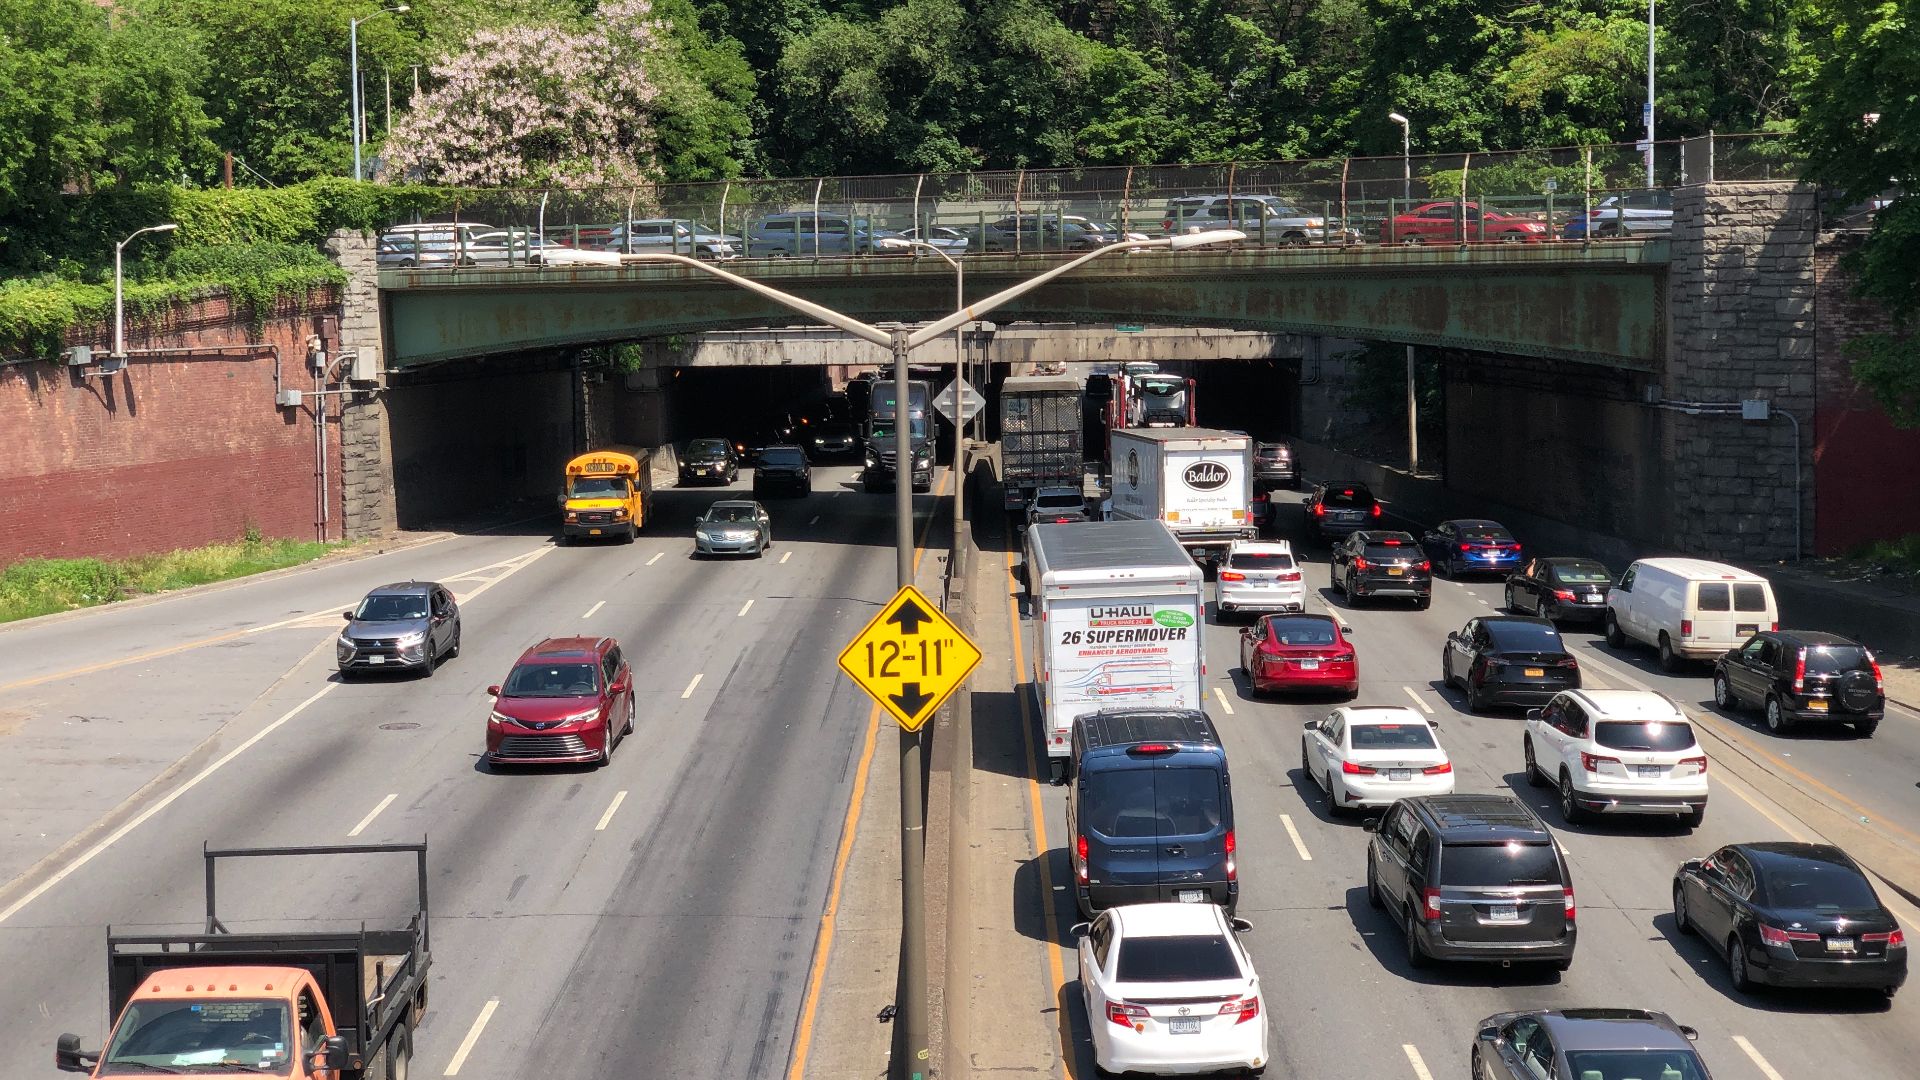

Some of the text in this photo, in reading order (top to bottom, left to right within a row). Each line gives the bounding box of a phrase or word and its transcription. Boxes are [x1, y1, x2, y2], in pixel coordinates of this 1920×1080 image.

[1187, 465, 1226, 483] Baldor
[1091, 606, 1151, 618] U-HAUL
[1086, 627, 1187, 644] SUPERMOVER
[865, 639, 954, 678] 12'-11"
[1115, 647, 1168, 655] AERODYNAMICS
